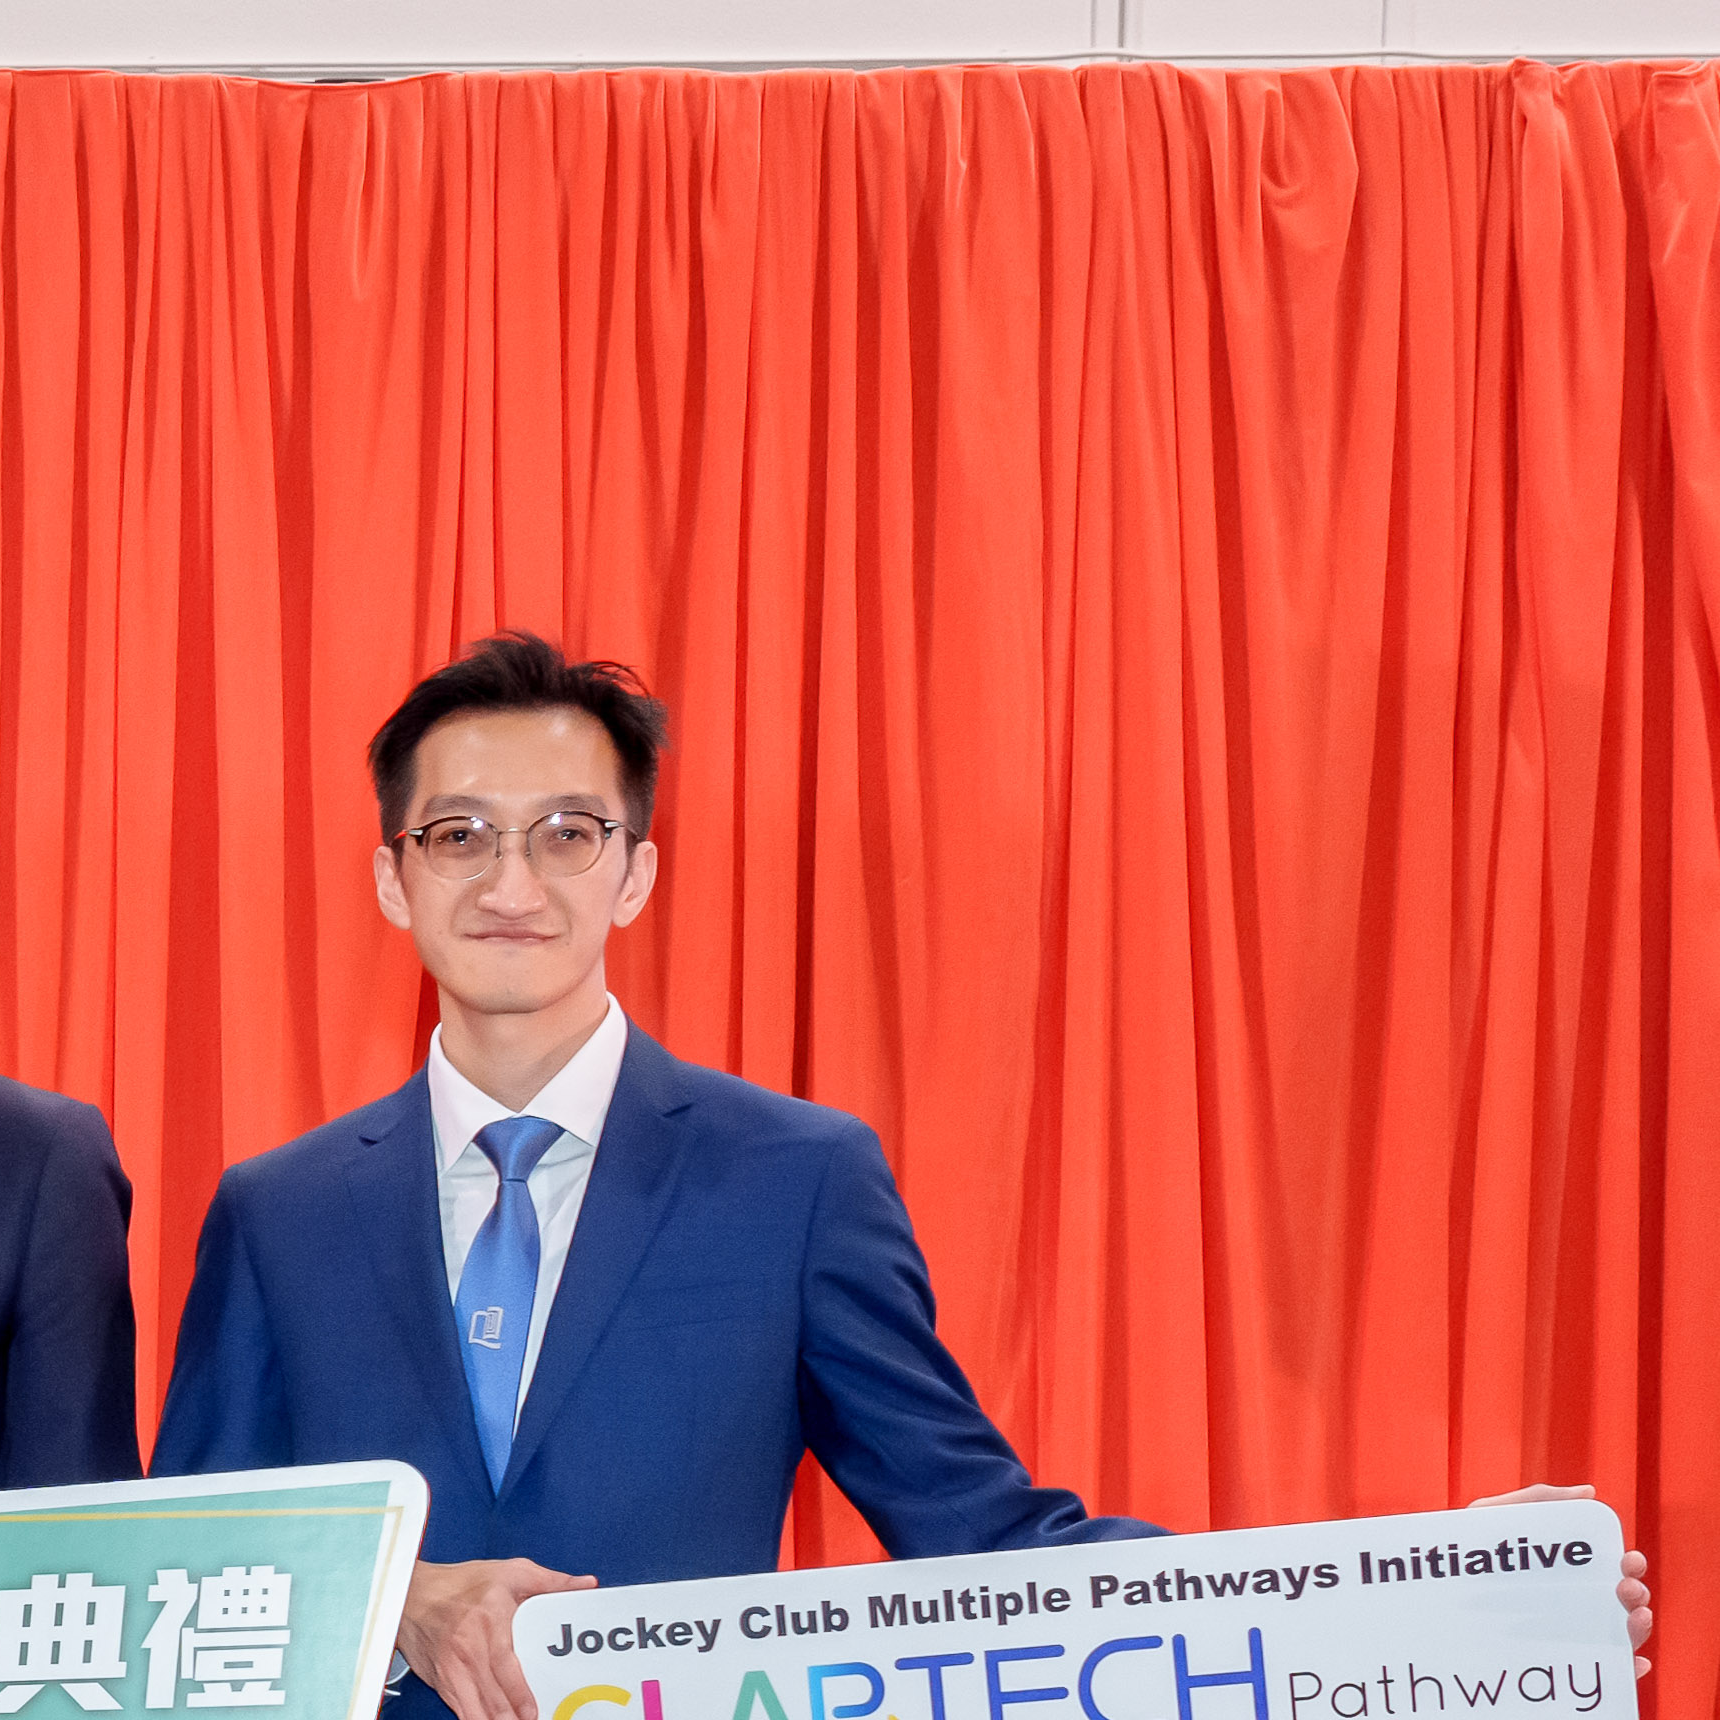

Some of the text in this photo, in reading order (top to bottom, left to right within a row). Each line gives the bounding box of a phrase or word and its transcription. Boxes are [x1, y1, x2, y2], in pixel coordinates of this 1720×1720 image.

[547, 1539, 1593, 1657] Jockey Club Multiple Pathways Initiative
